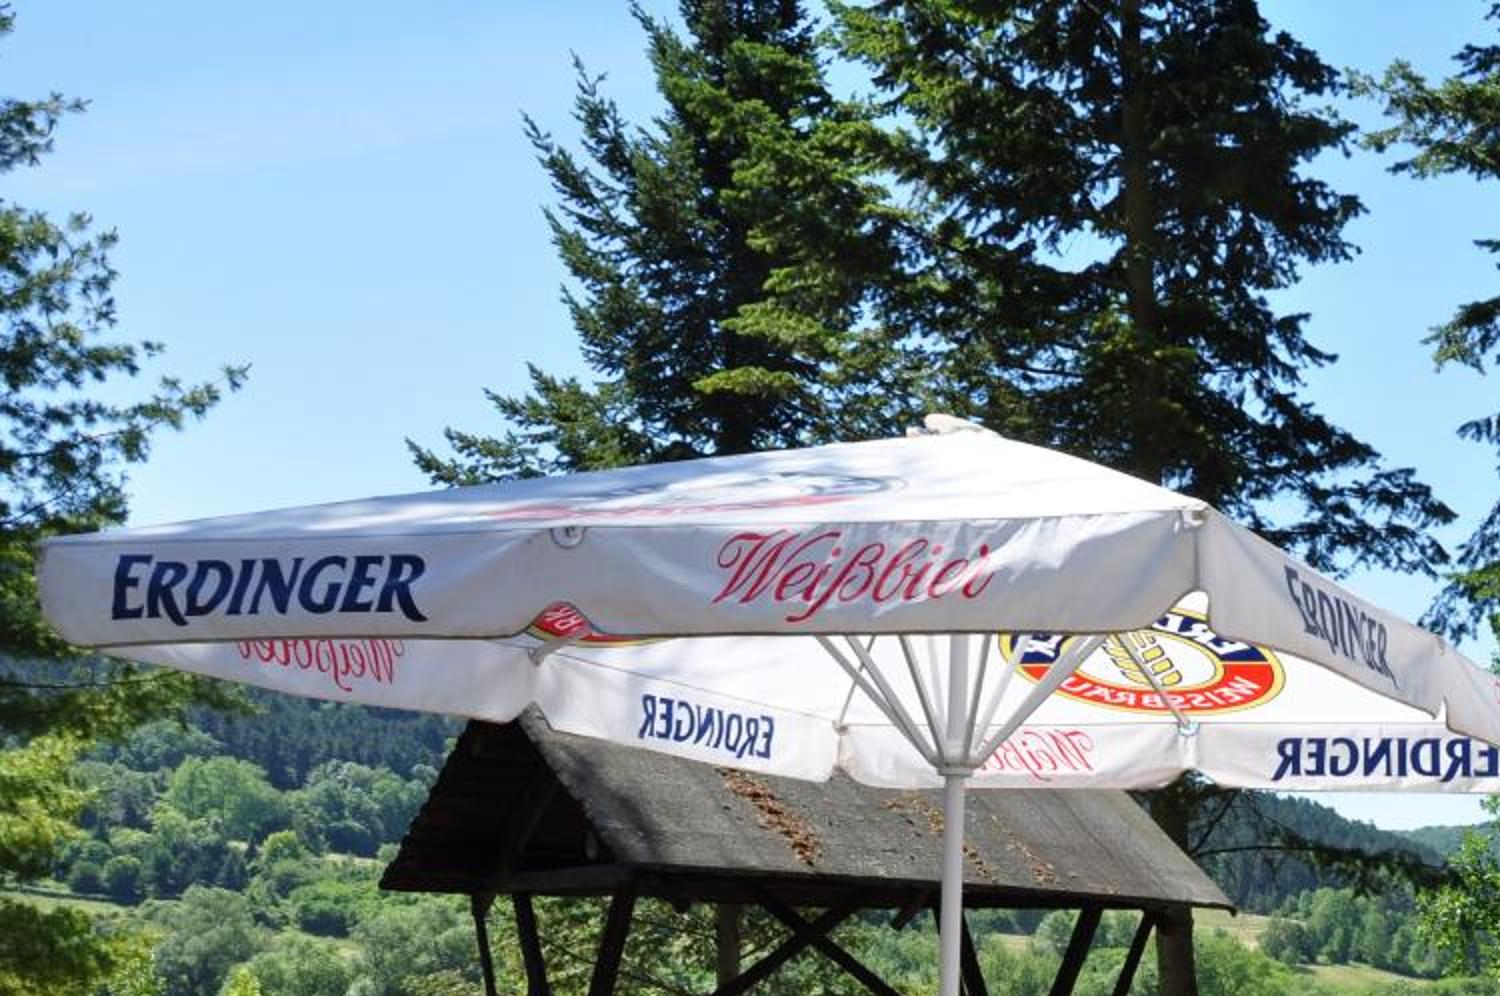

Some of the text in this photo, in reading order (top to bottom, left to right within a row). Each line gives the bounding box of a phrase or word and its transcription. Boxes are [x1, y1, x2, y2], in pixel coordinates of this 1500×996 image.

[112, 554, 428, 627] ERDINGER
[711, 529, 994, 622] Weißbier
[1285, 566, 1398, 689] ERDINGER
